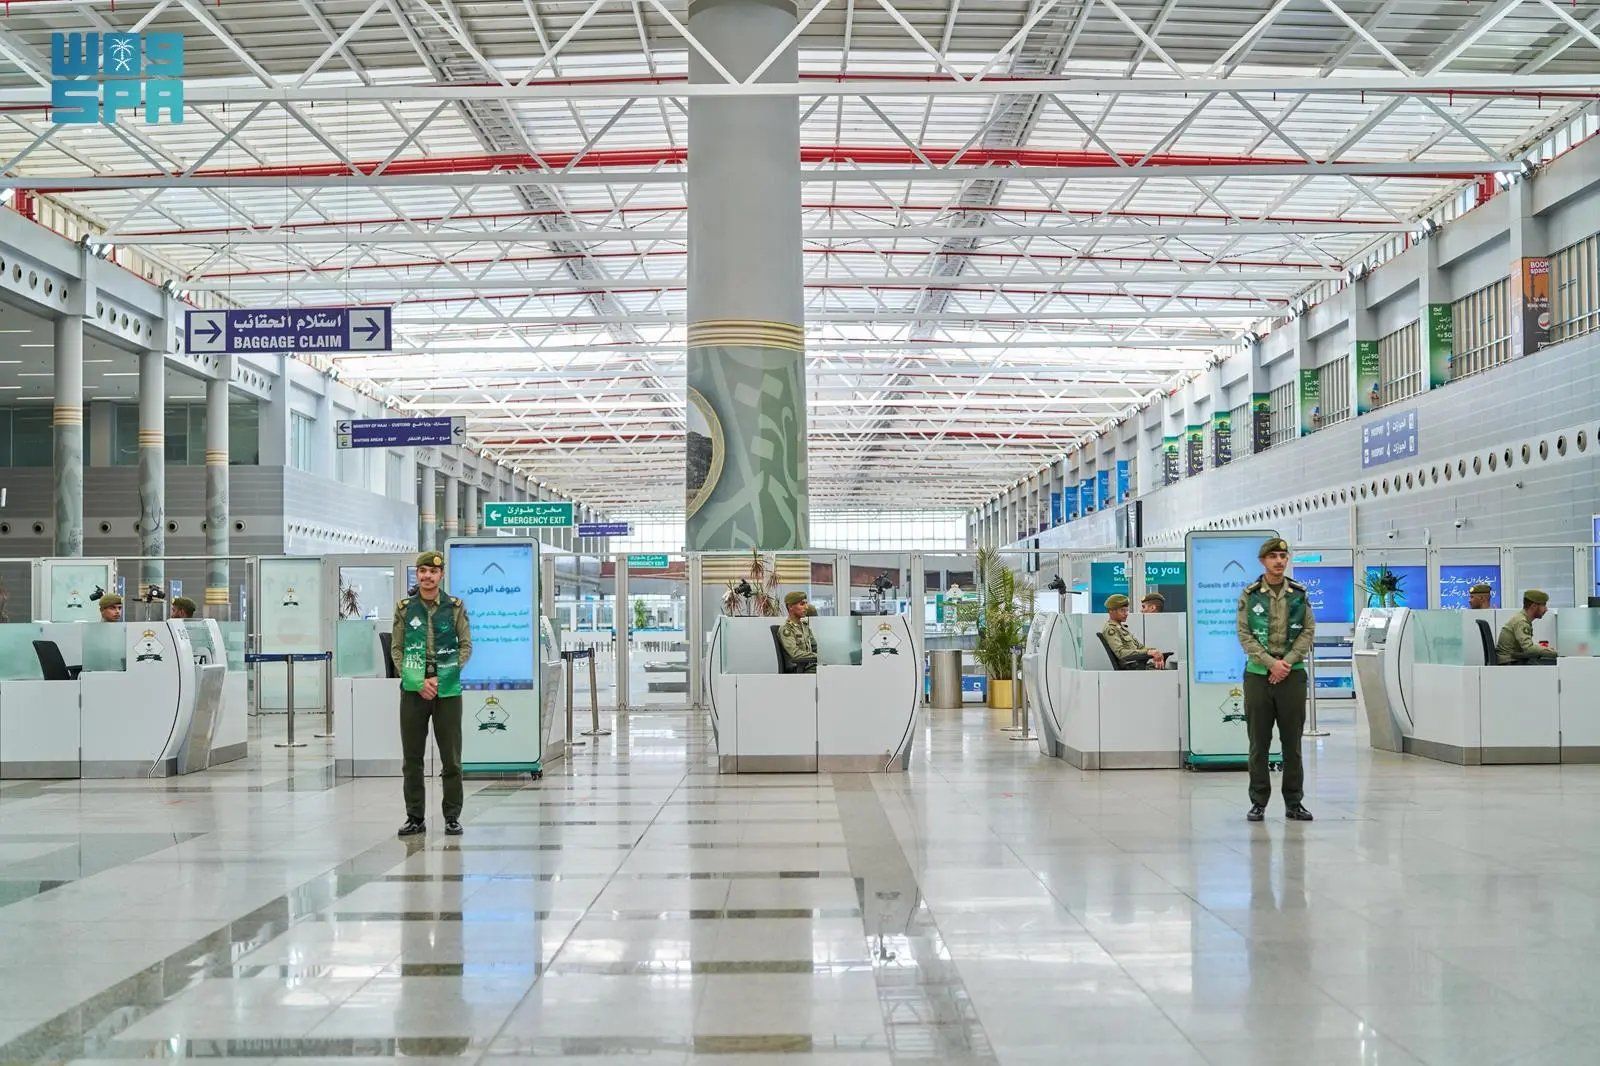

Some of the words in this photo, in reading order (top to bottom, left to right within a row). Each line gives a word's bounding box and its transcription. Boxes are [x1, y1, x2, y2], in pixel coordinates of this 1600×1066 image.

[233, 314, 291, 332] الحقائب
[297, 313, 341, 331] استلام
[233, 335, 295, 348] BAGGAGE
[299, 335, 342, 348] CLAIM
[507, 506, 534, 515] طوارئ
[535, 506, 562, 515] مخرج
[503, 516, 548, 524] EMERGENCY
[549, 516, 566, 524] EXIT
[1147, 566, 1158, 575] to
[1161, 567, 1180, 577] you
[406, 652, 421, 661] ask
[405, 660, 424, 669] me
